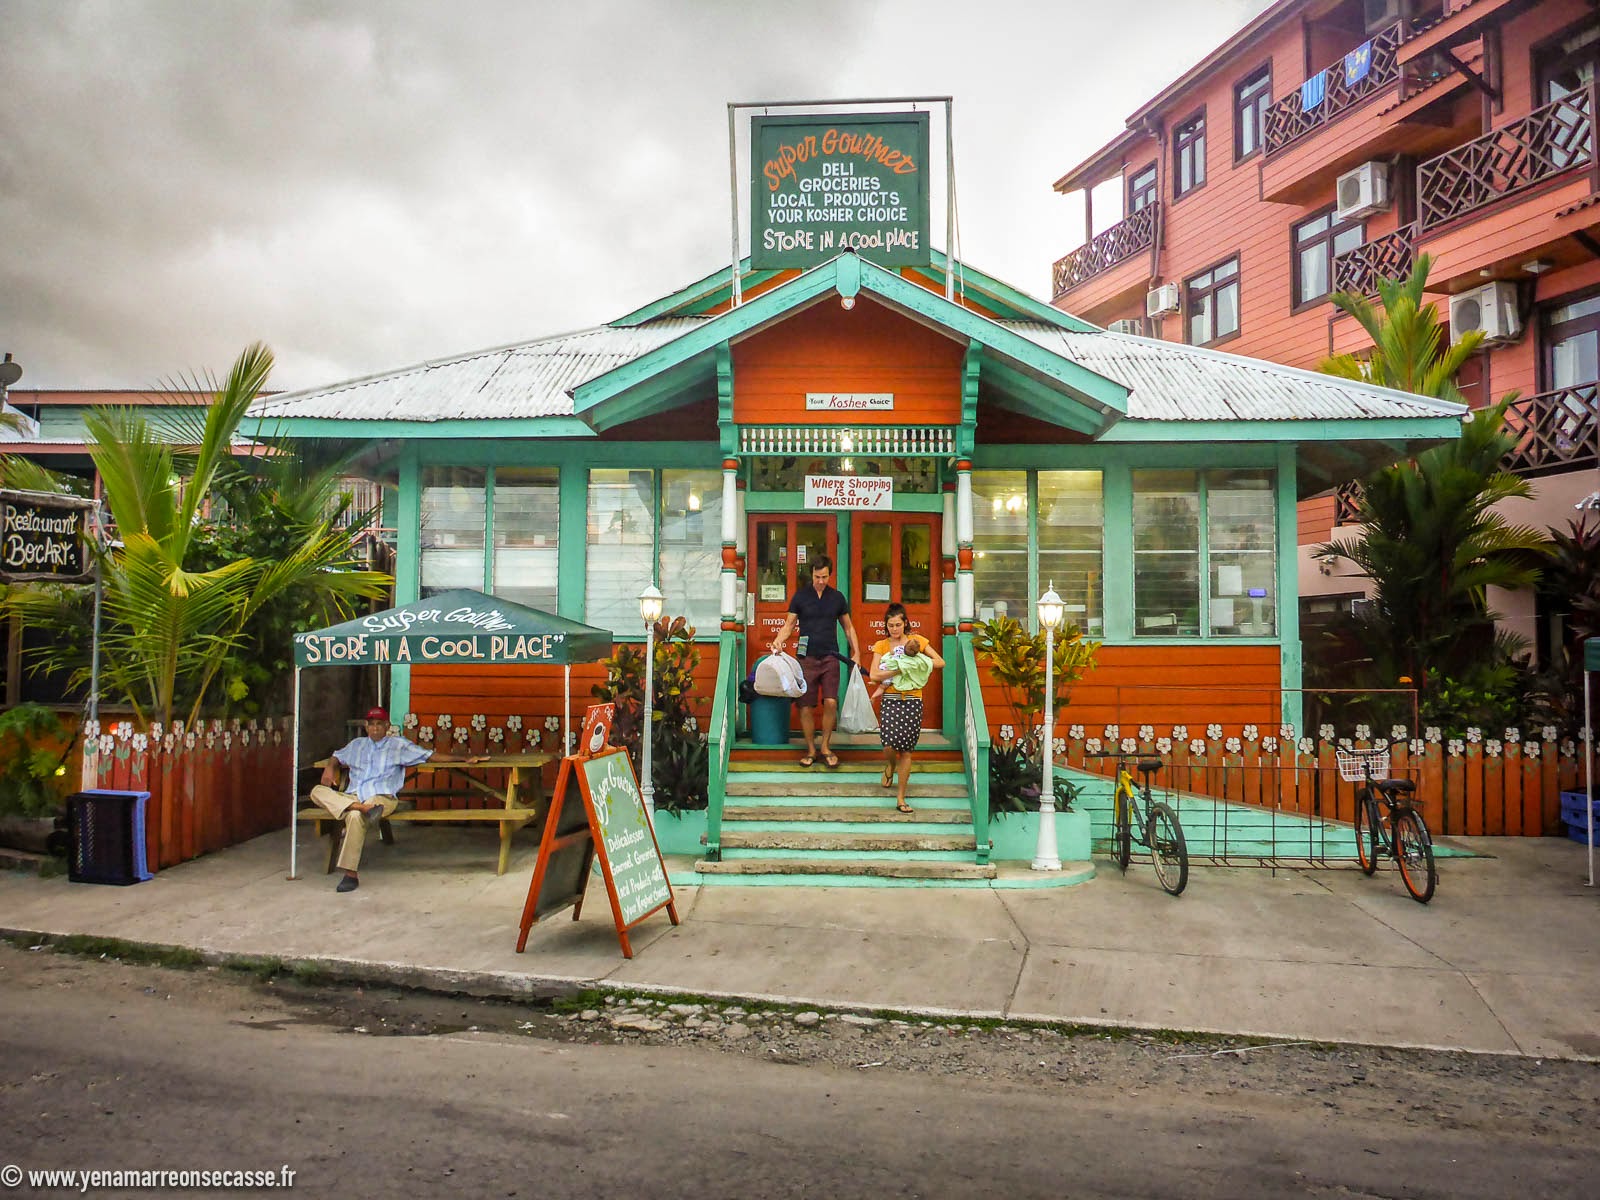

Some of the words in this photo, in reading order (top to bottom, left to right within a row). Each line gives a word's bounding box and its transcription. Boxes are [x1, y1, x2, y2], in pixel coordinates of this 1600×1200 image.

[763, 136, 818, 191] Super
[822, 129, 917, 174] Gourmet
[822, 162, 854, 177] DELI
[799, 177, 881, 193] GROCERIES
[771, 193, 815, 208] LOCAL
[824, 192, 900, 206] PRODUCTS
[768, 208, 803, 224] YOUR
[806, 208, 854, 222] KOSHER
[857, 207, 908, 222] CHOICE
[763, 228, 814, 252] STORE
[819, 230, 834, 252] IN
[838, 232, 848, 248] A
[811, 478, 845, 489] Where
[849, 478, 891, 492] Shopping
[834, 487, 845, 497] is
[848, 489, 857, 497] a
[4, 505, 78, 535] Restaurant
[363, 609, 442, 633] Super
[374, 638, 390, 662] IN
[397, 635, 412, 662] A
[421, 635, 485, 659] COOL
